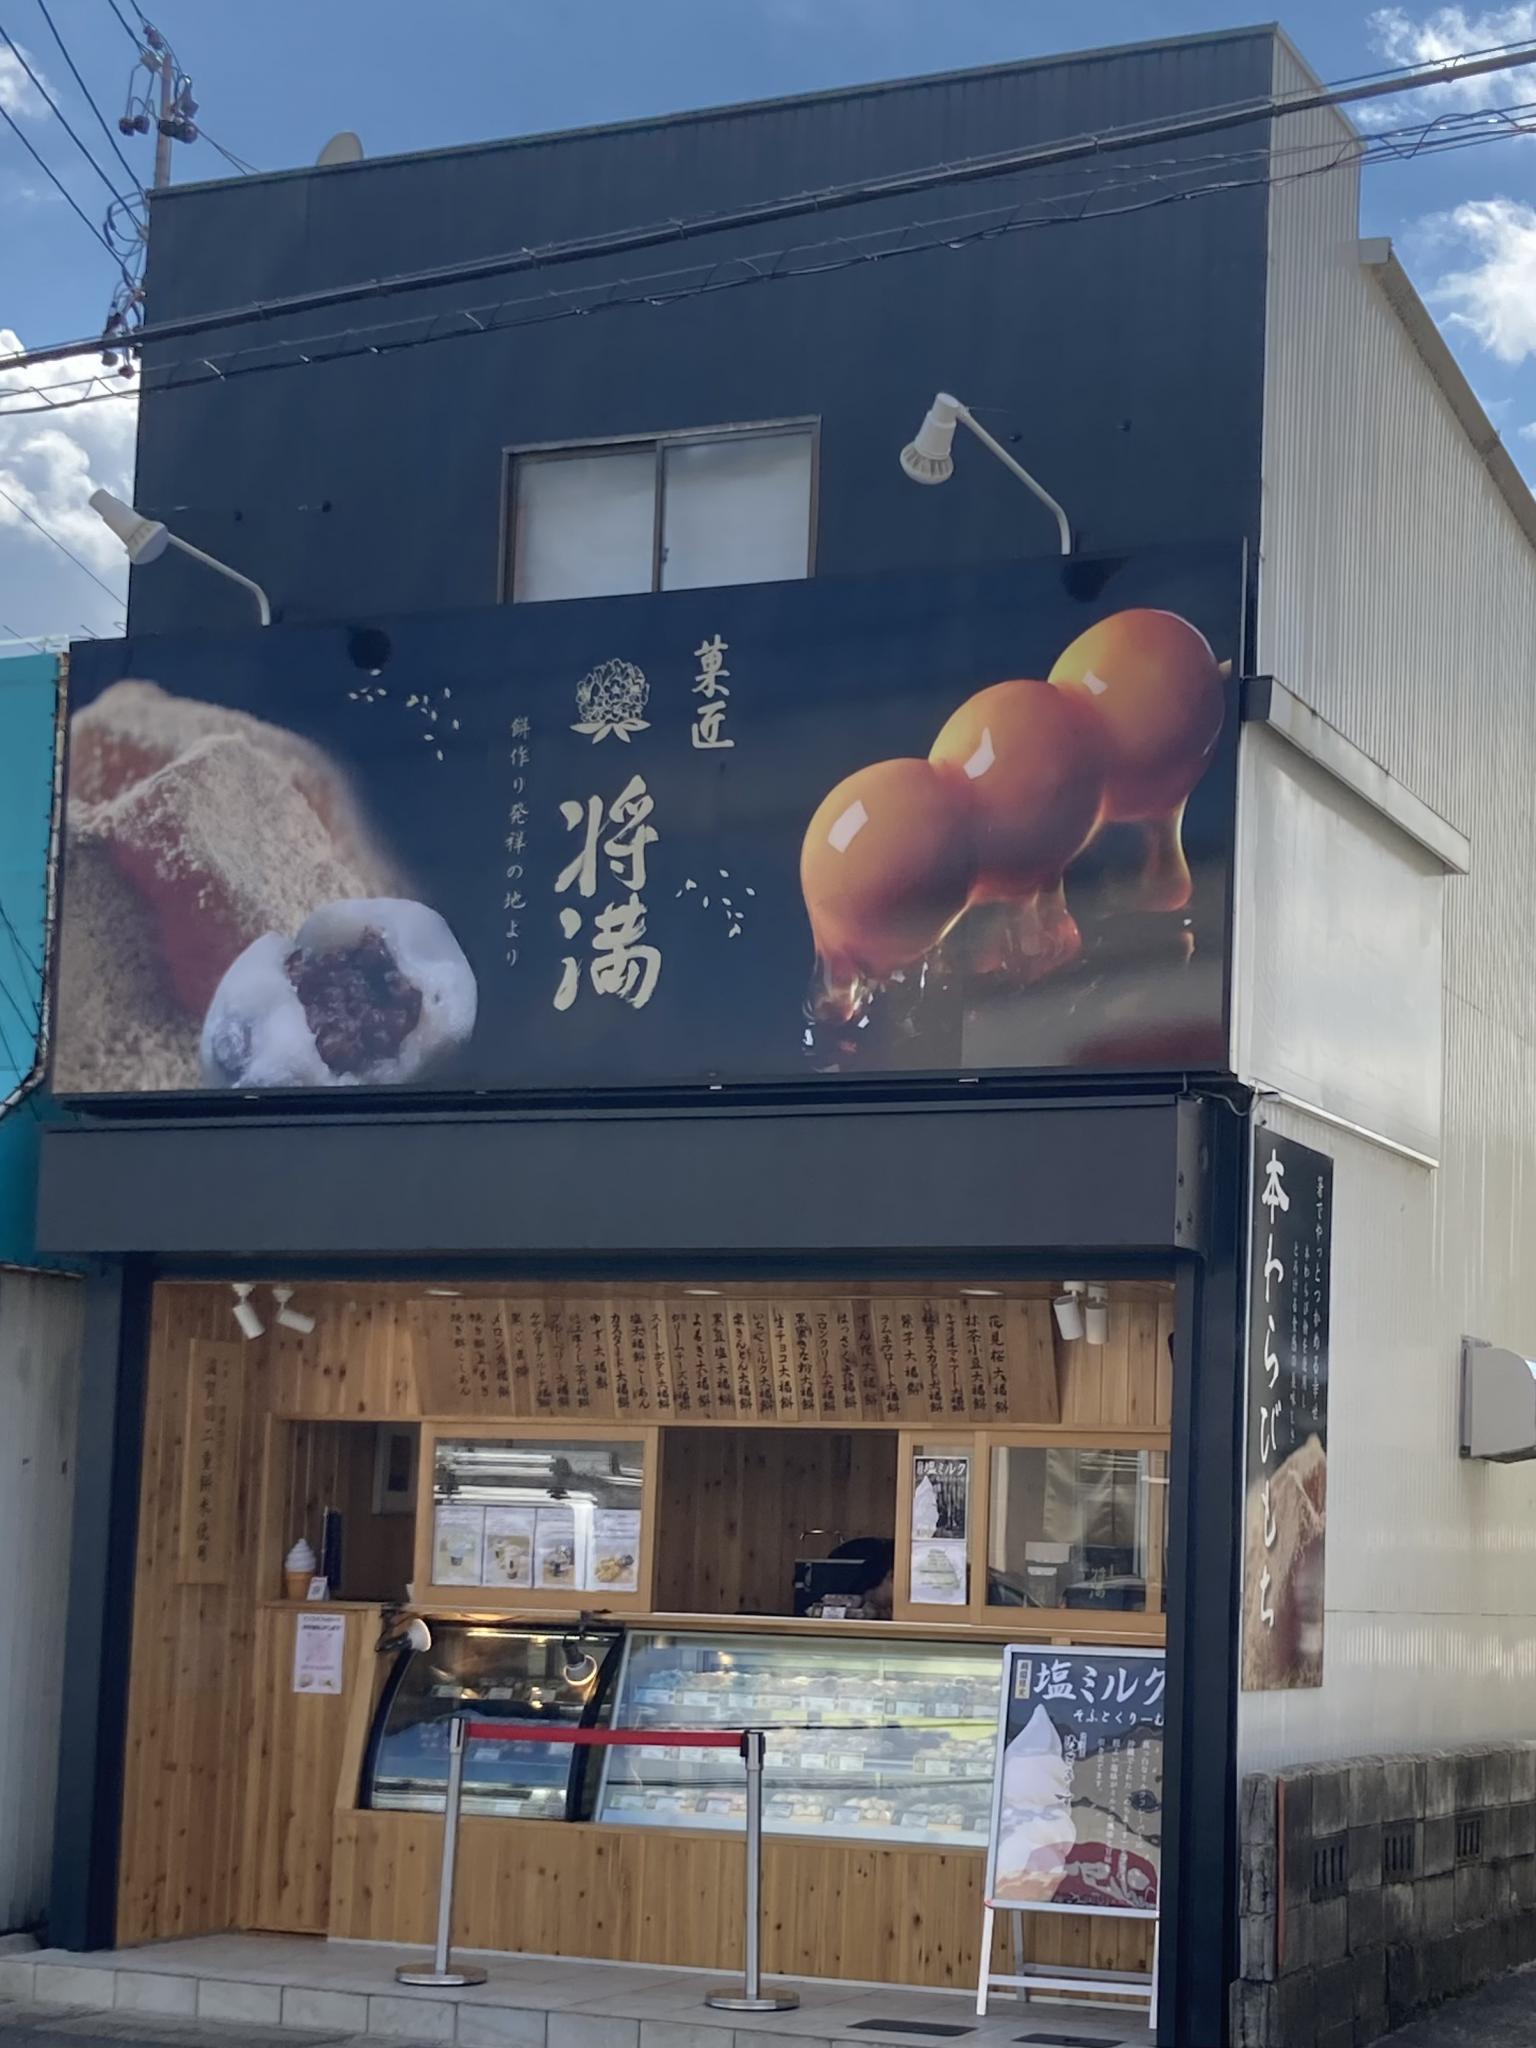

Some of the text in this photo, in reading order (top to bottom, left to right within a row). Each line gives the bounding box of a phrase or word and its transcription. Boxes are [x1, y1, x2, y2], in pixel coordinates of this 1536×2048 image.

[691, 633, 735, 750] 菓匠
[503, 716, 531, 967] 餅作り発祥の地より
[553, 774, 662, 1011] 将満
[774, 1315, 794, 1410] 生チョコ大福餅
[1261, 1148, 1290, 1632] 本わらびもち
[1033, 1658, 1166, 1706] 塩ミルク
[1073, 1708, 1165, 1726] そふとくりーむ
